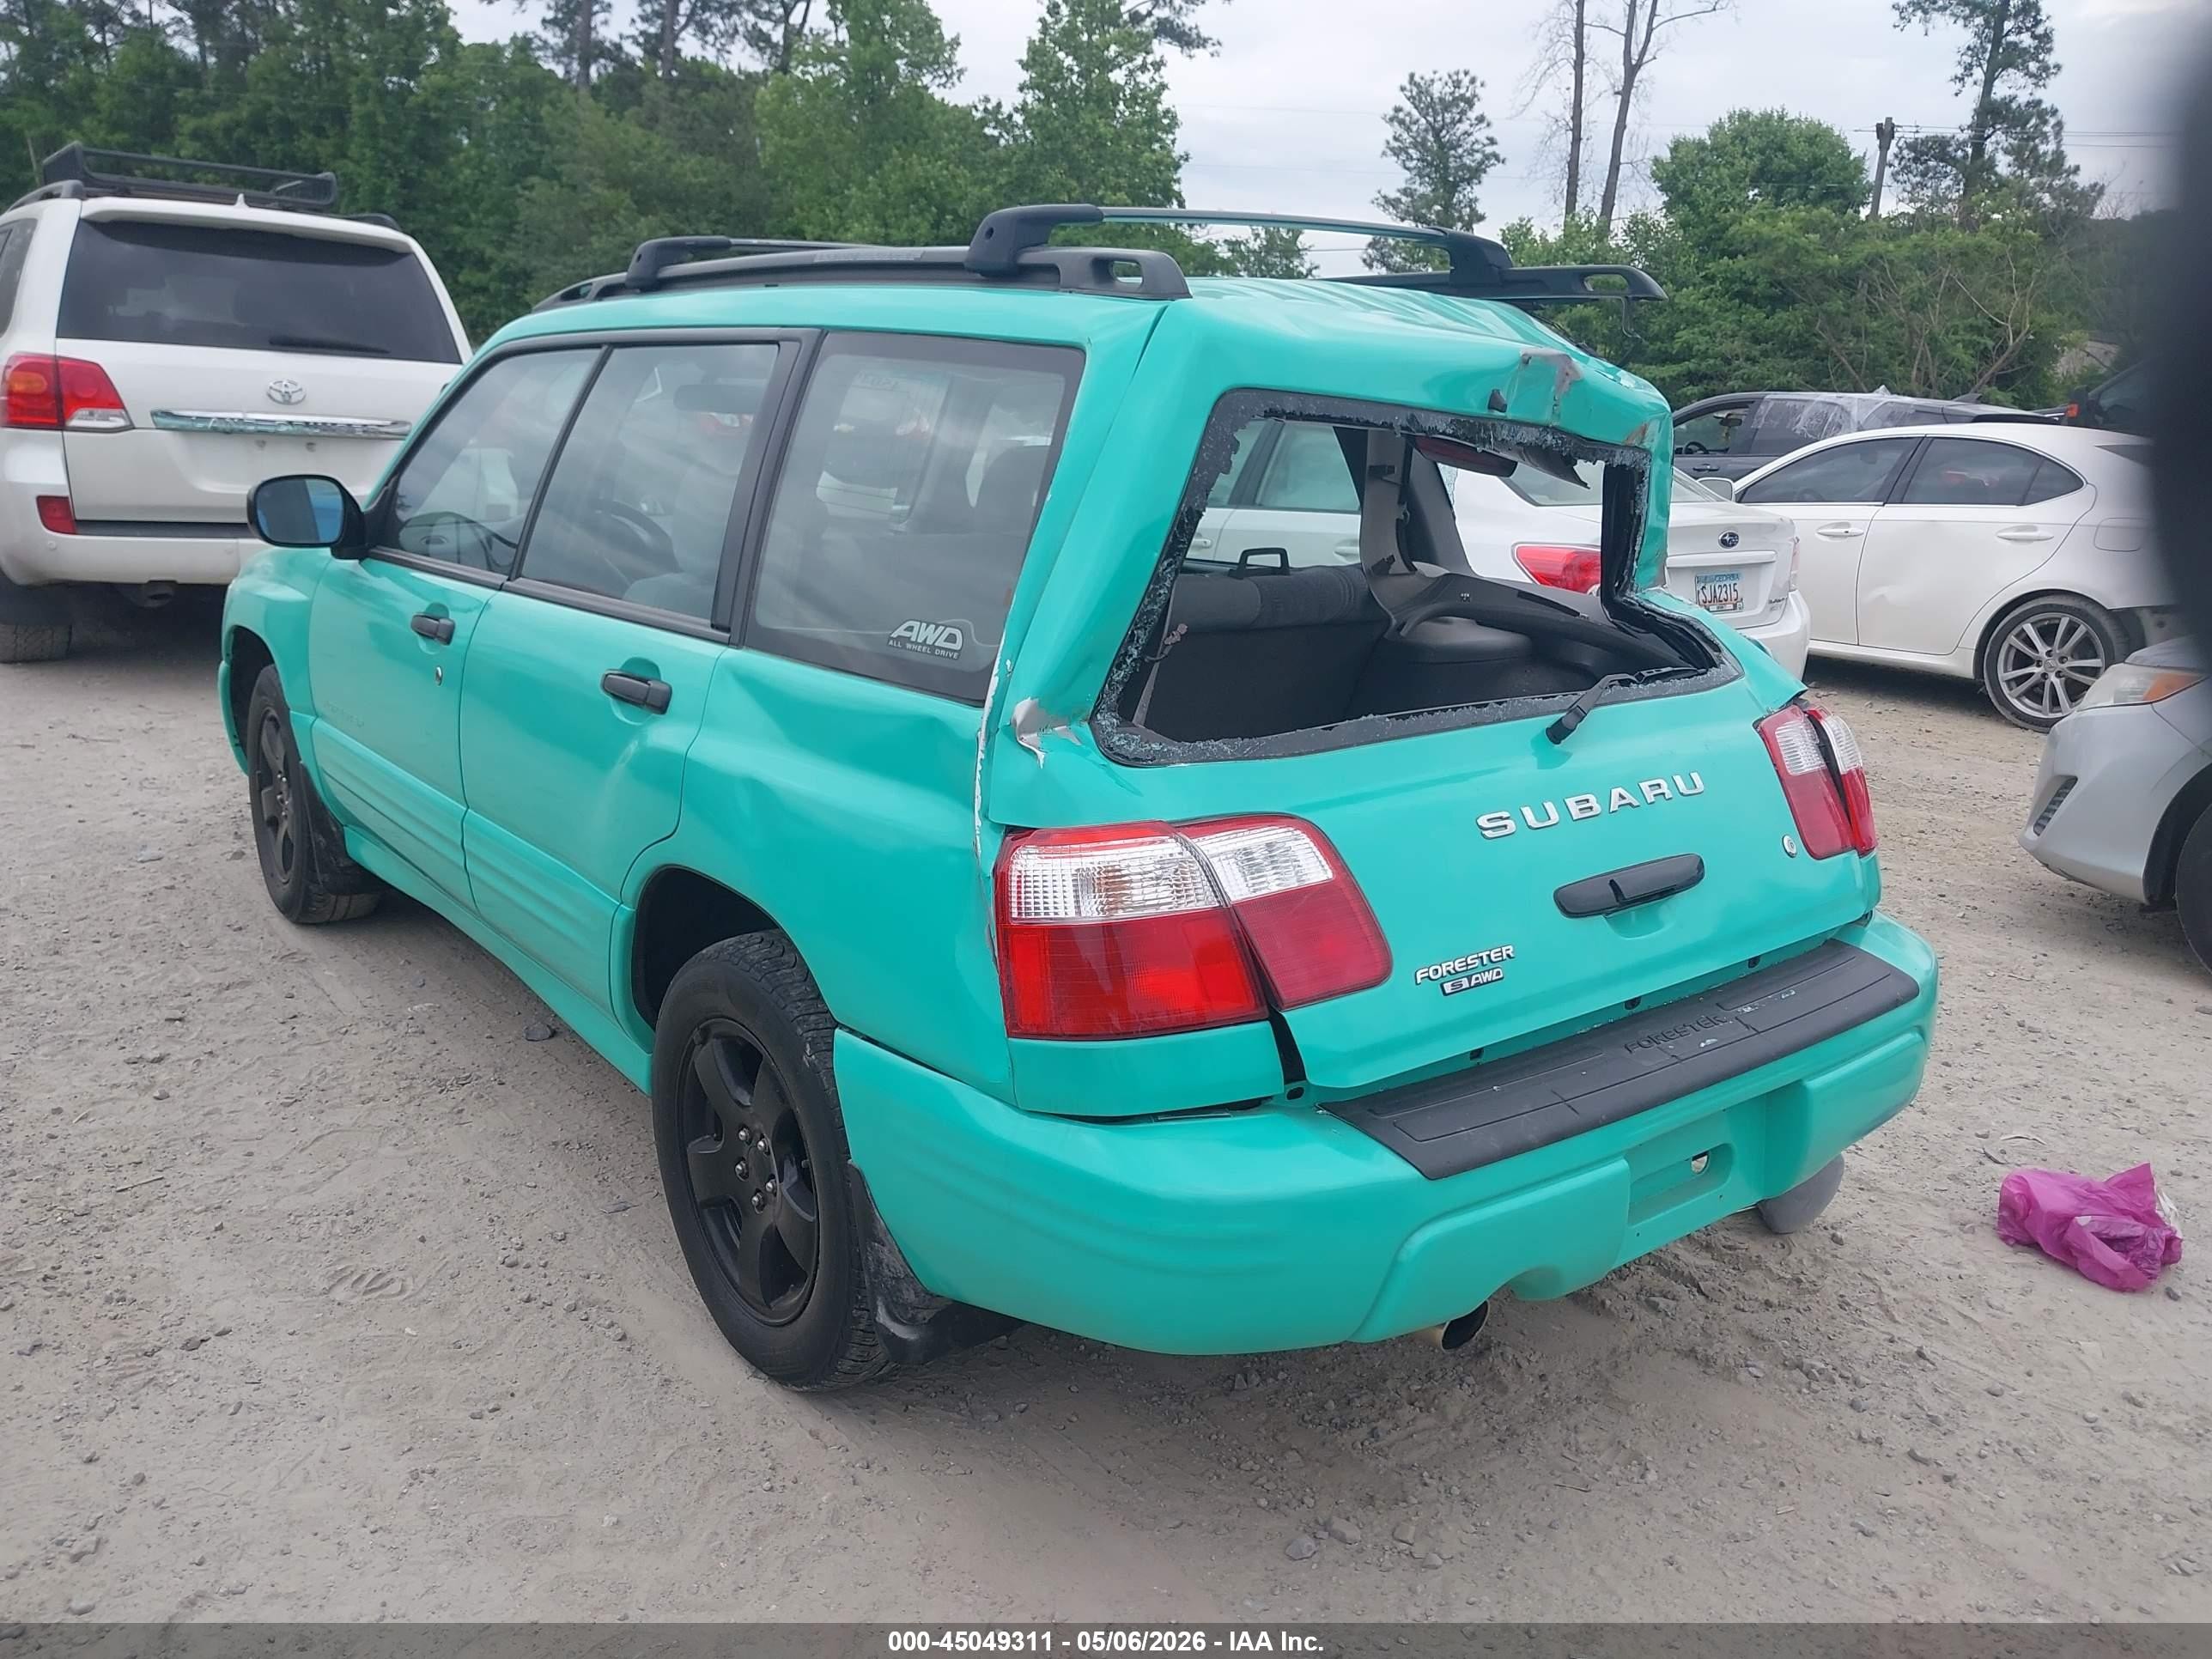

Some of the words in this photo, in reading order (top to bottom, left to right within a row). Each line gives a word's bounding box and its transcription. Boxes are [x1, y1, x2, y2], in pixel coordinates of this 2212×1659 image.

[1700, 583, 1739, 604] SJA2315
[890, 620, 963, 650] AWD
[906, 642, 932, 653] WHEEL
[934, 648, 959, 659] DRIVE
[1476, 771, 1705, 840] SUBARU
[1415, 945, 1515, 985] FORESTER
[1470, 968, 1504, 988] AWD
[1624, 1015, 1728, 1054] FORESTER
